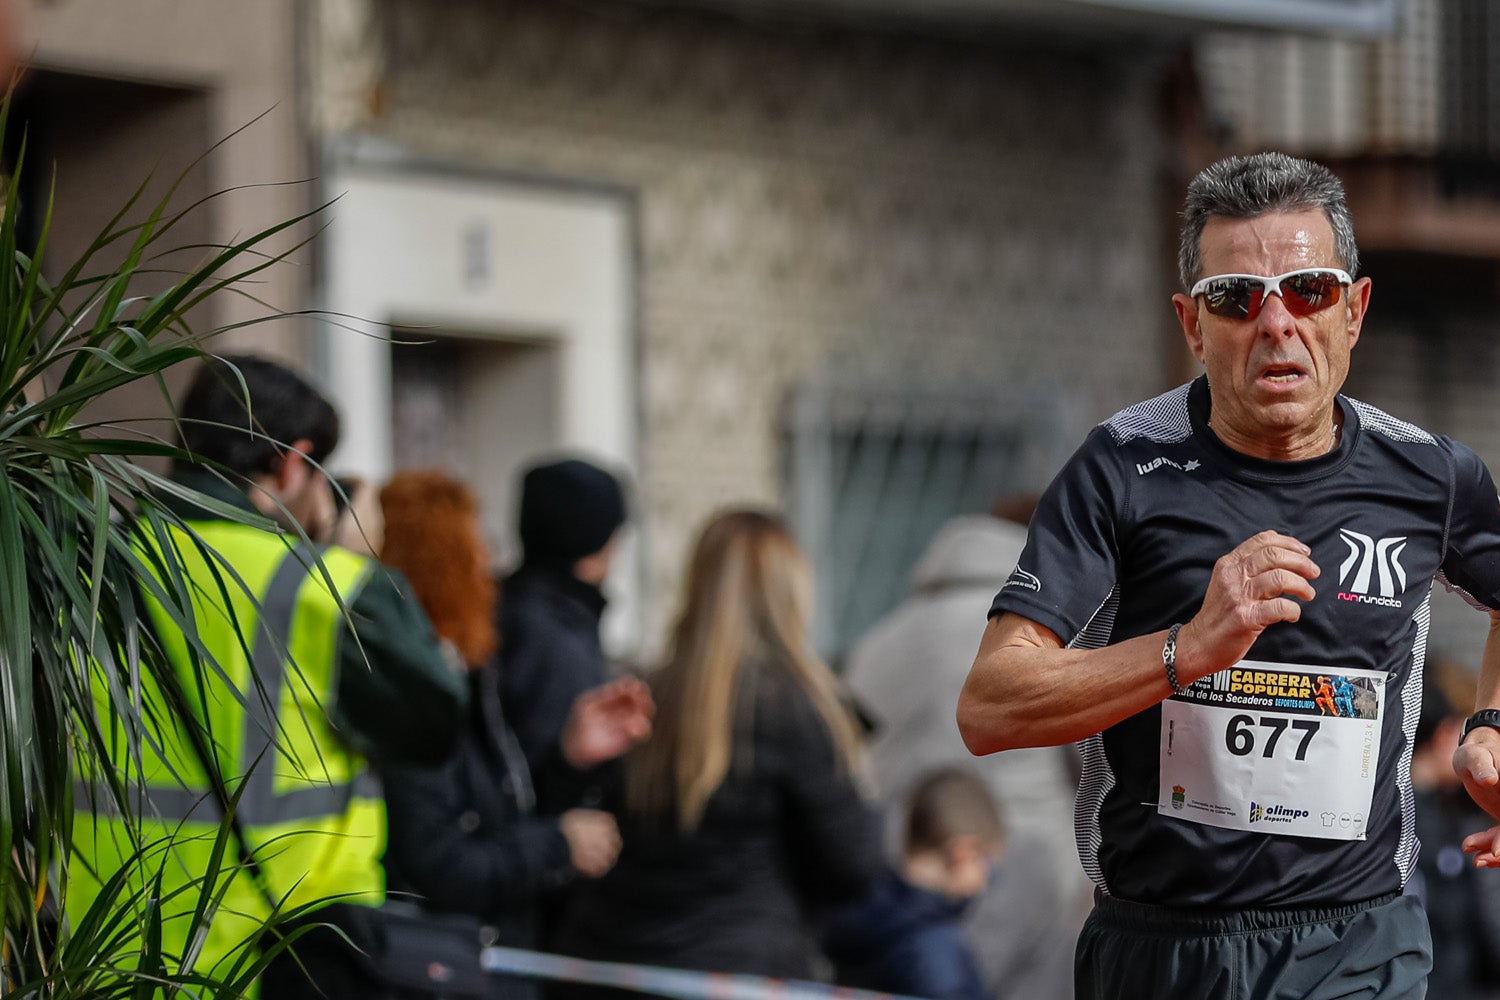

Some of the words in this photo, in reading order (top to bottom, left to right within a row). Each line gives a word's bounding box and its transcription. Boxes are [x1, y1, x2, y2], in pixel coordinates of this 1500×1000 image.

[1337, 592, 1402, 608] runrundata
[1231, 670, 1312, 688] CARRERA
[1174, 687, 1195, 698] uta
[1196, 690, 1208, 700] de
[1209, 691, 1224, 702] los
[1225, 693, 1274, 706] Secaderos
[1231, 682, 1311, 698] POPULAR
[1275, 698, 1298, 708] DEPORTES
[1225, 714, 1321, 761] 677
[1263, 815, 1292, 823] deportes
[1266, 804, 1310, 819] olimpo
